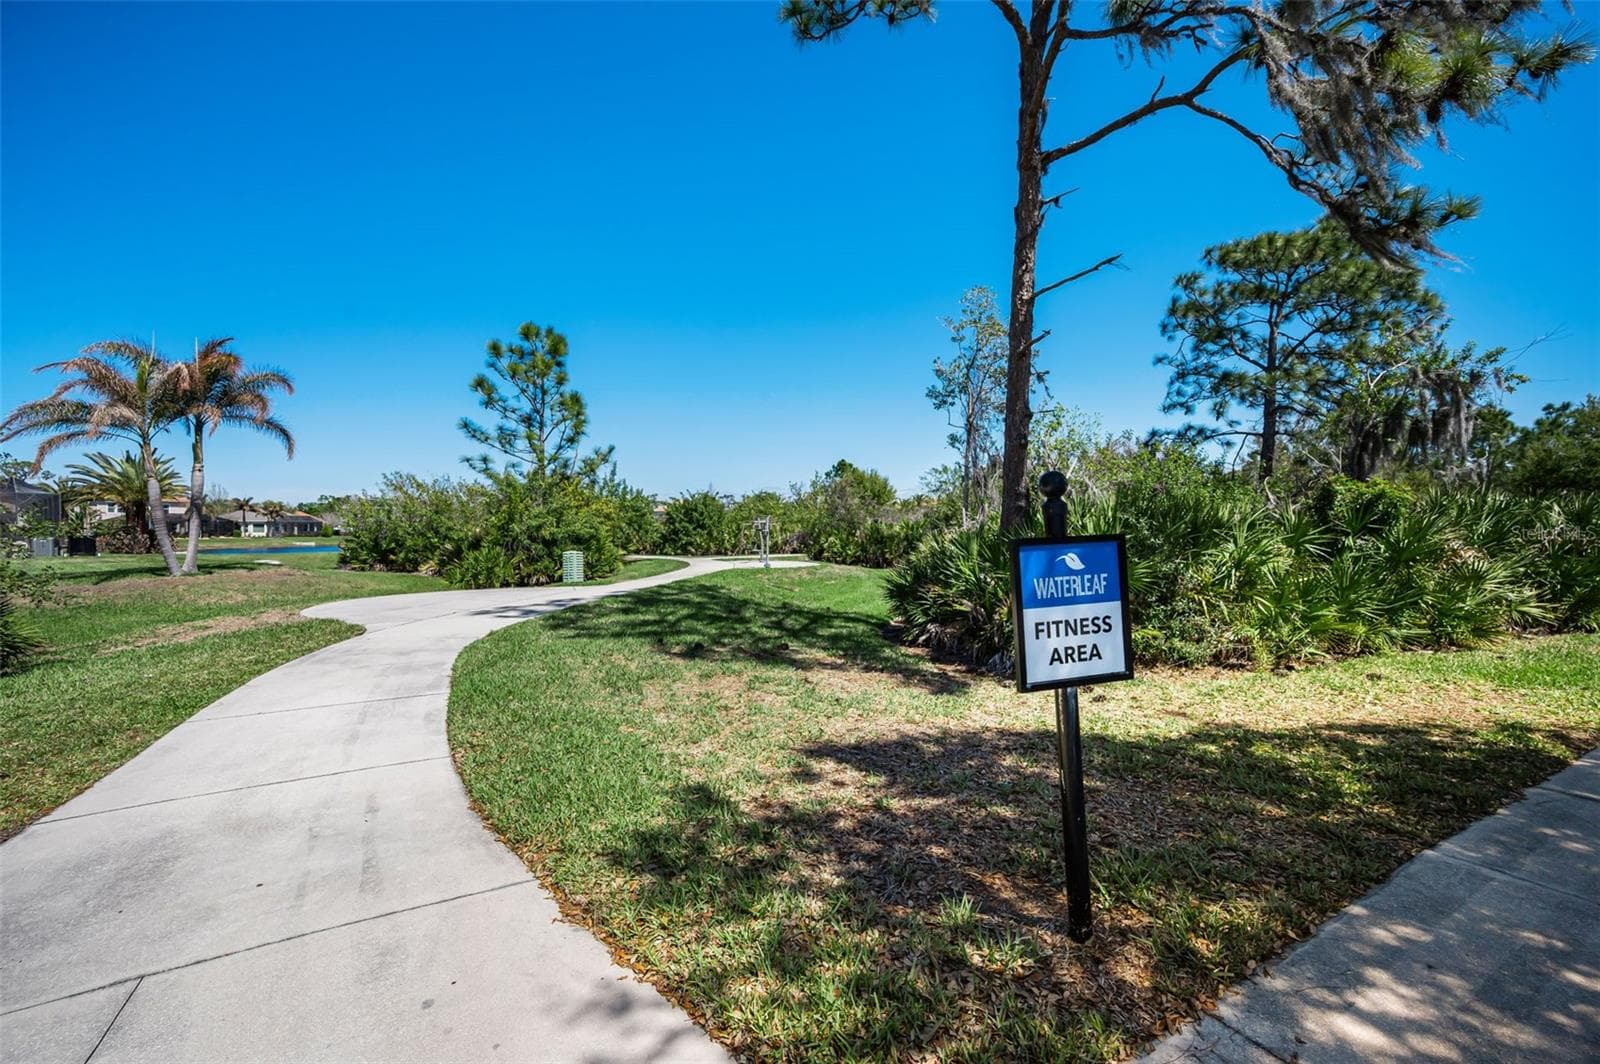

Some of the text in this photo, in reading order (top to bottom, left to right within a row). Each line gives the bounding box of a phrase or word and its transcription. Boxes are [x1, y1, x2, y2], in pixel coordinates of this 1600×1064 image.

[1034, 573, 1108, 599] WATERLEAF
[1035, 615, 1112, 640] FITNESS
[1049, 643, 1102, 666] AREA
